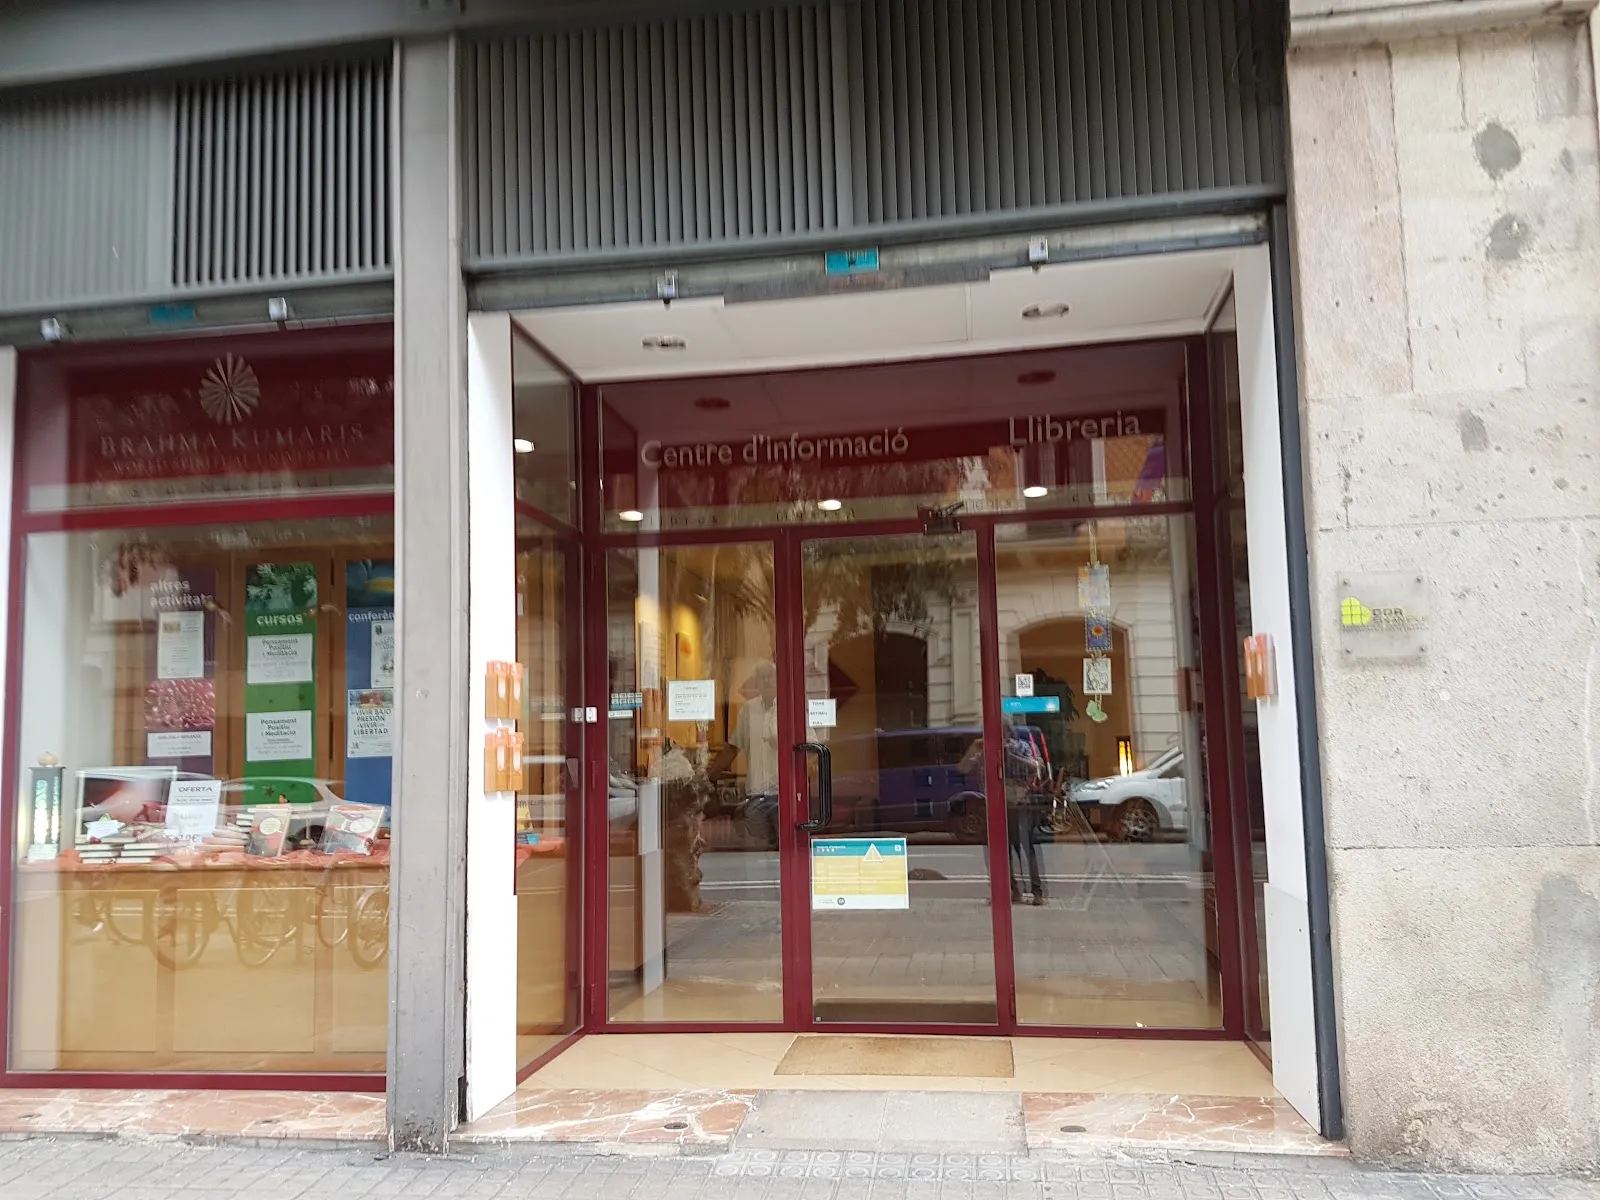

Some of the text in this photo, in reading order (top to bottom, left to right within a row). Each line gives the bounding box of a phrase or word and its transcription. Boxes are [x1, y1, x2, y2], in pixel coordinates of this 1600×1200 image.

[100, 423, 364, 457] BRAHMA KUMARIS
[1008, 409, 1141, 445] Llibreria
[641, 427, 910, 470] Centre d'informació
[256, 613, 304, 626] cursos
[353, 727, 389, 736] LIBERTAD
